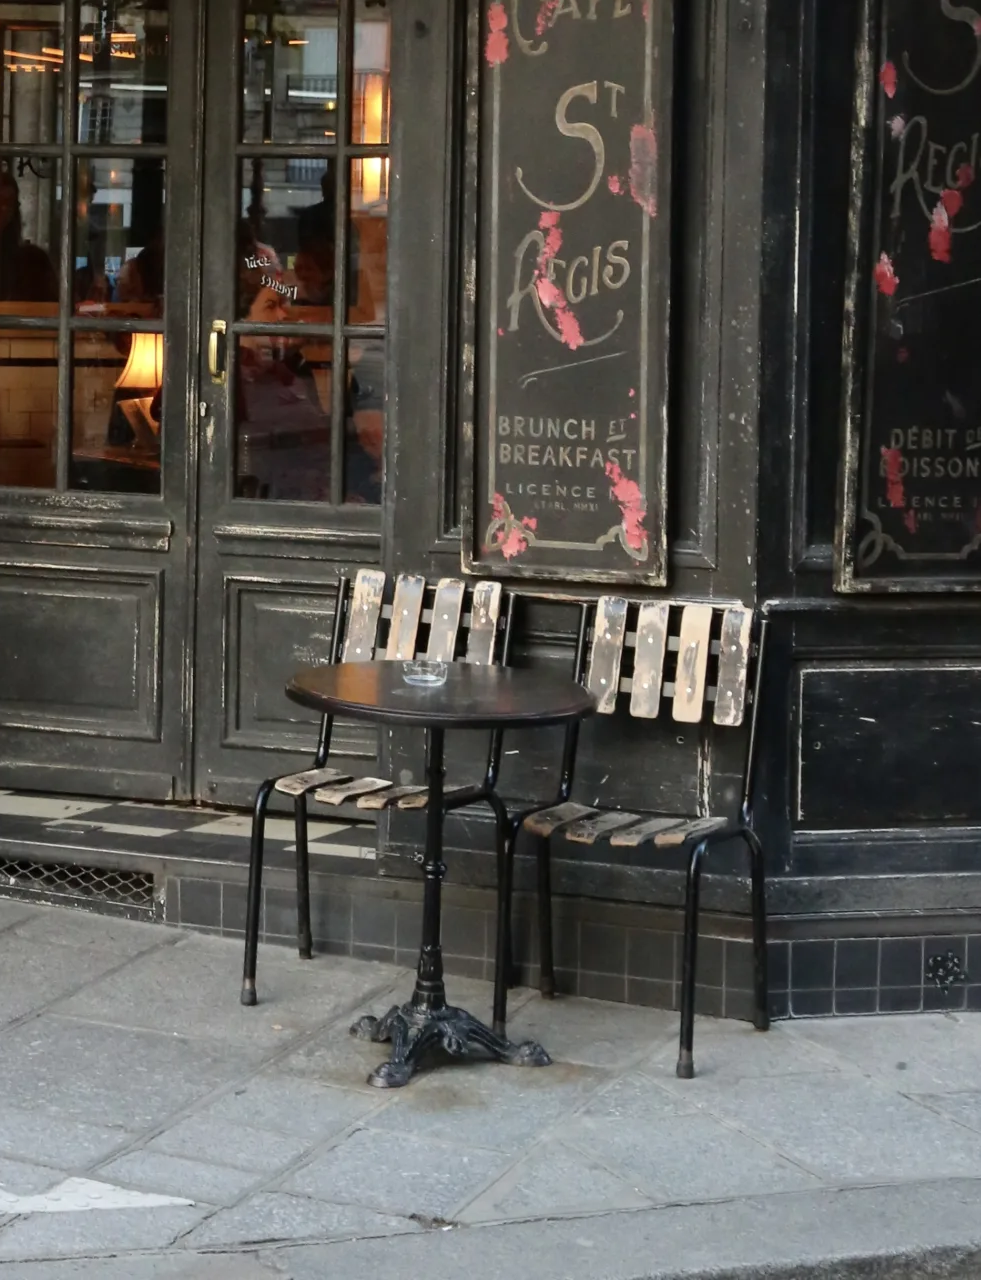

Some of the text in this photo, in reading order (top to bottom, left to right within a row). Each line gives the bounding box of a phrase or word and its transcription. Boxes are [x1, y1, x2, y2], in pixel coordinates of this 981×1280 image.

[497, 415, 628, 441] BRUNCH ET
[890, 425, 957, 449] DÉBIT
[498, 443, 637, 470] BREAKFAST
[505, 482, 597, 499] LICENCE
[877, 496, 962, 508] LENCE
